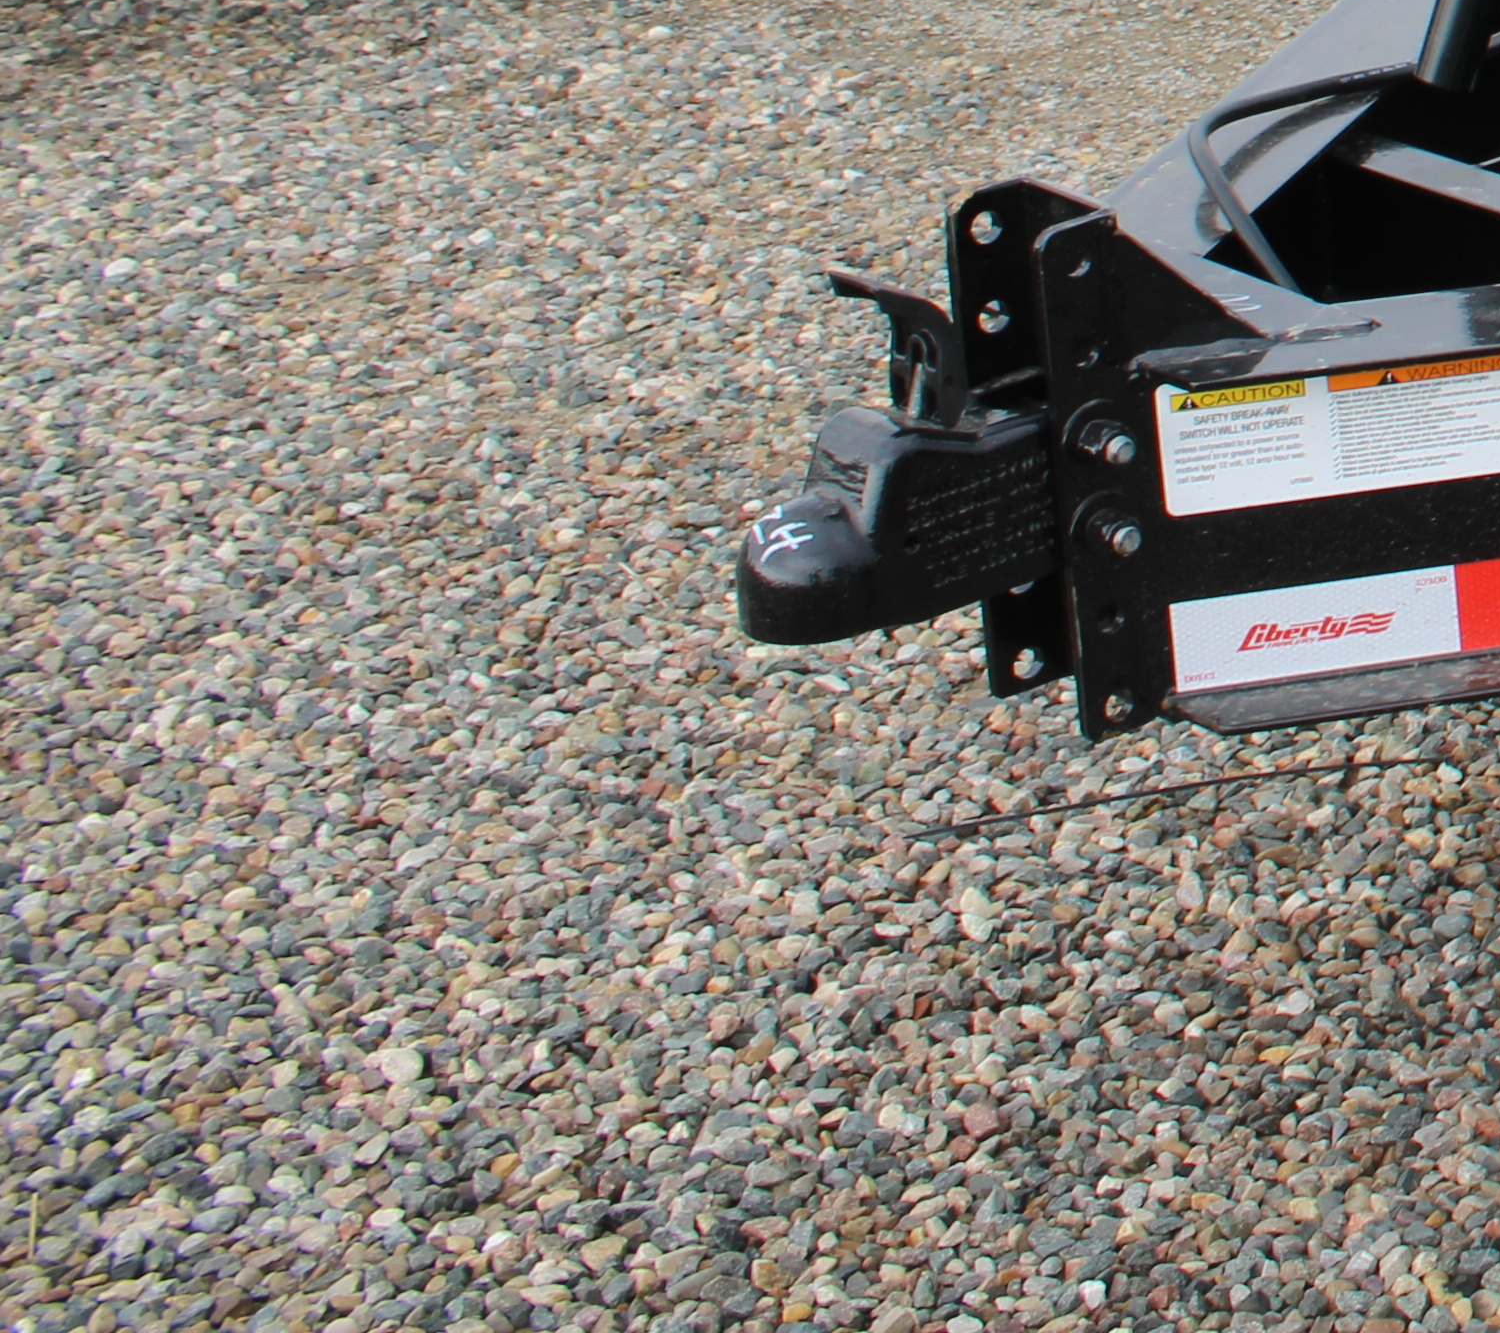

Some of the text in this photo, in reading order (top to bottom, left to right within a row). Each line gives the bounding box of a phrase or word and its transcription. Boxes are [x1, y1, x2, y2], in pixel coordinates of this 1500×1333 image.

[1201, 383, 1300, 407] CAUTION
[1194, 405, 1290, 426] SAFETY BREAK-AWAY
[1180, 416, 1305, 441] SWITCH WILL NOT OPERATE
[1237, 616, 1351, 652] Liberty
